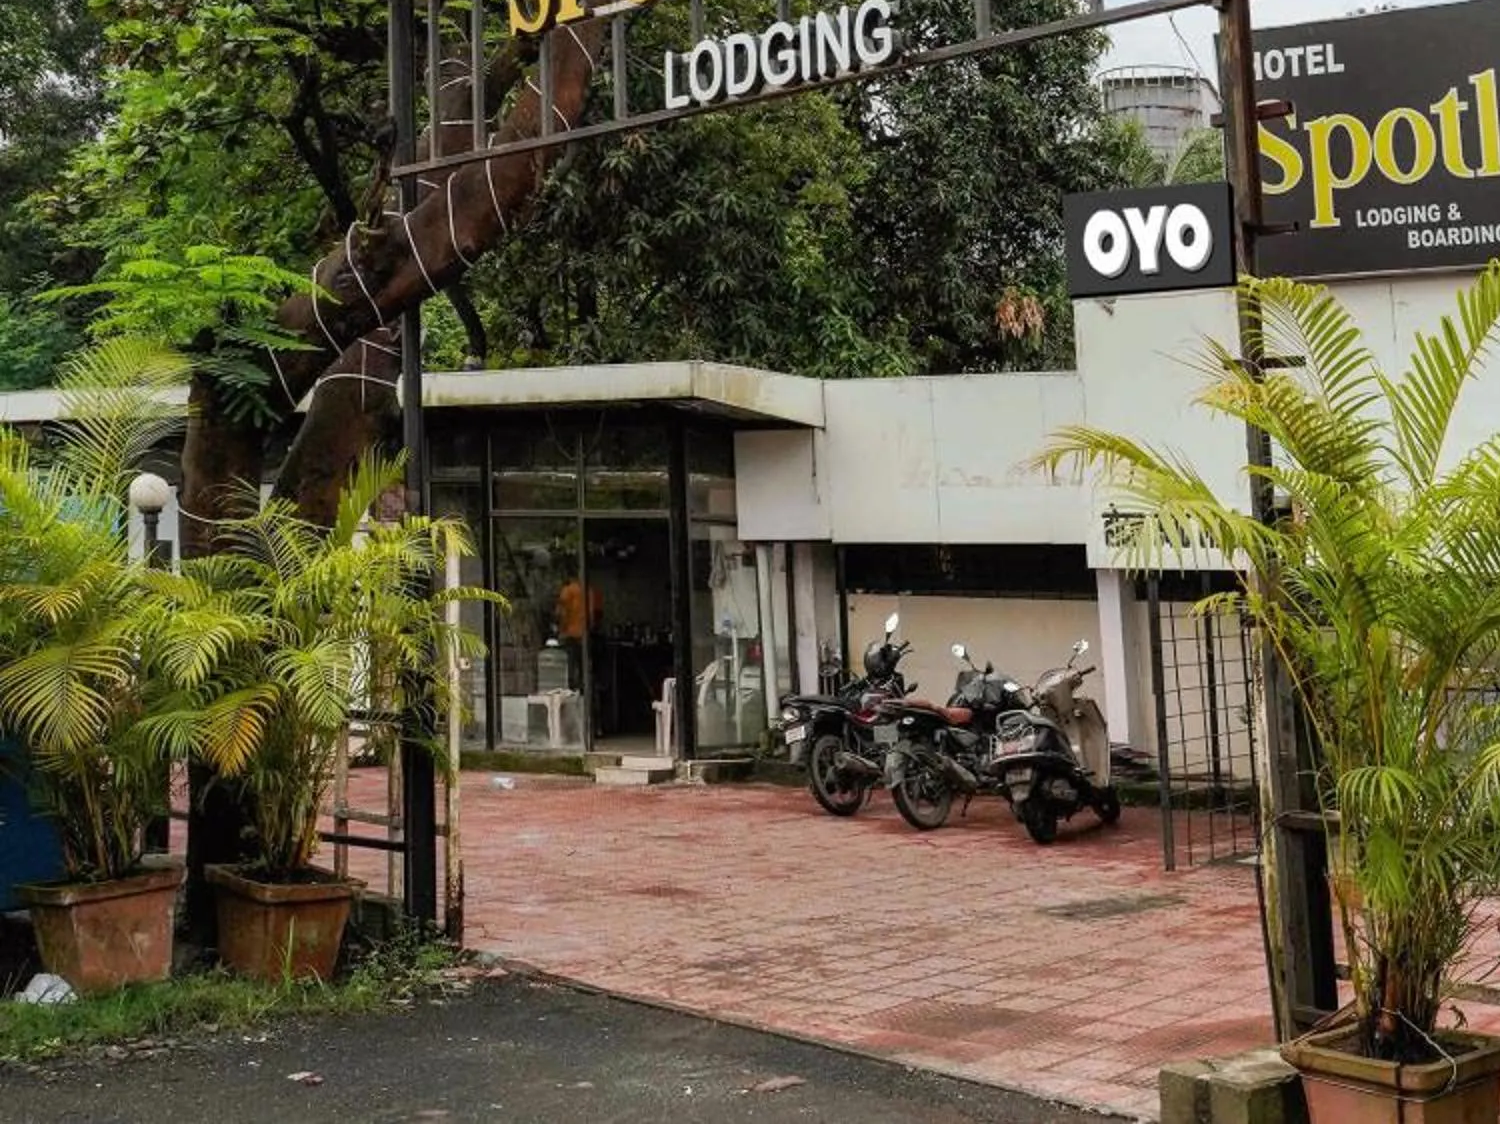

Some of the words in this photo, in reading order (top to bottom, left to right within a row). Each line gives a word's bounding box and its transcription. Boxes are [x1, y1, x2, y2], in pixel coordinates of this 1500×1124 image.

[1356, 203, 1441, 228] LODGING
[1447, 202, 1462, 221] &
[1083, 203, 1213, 278] OYO
